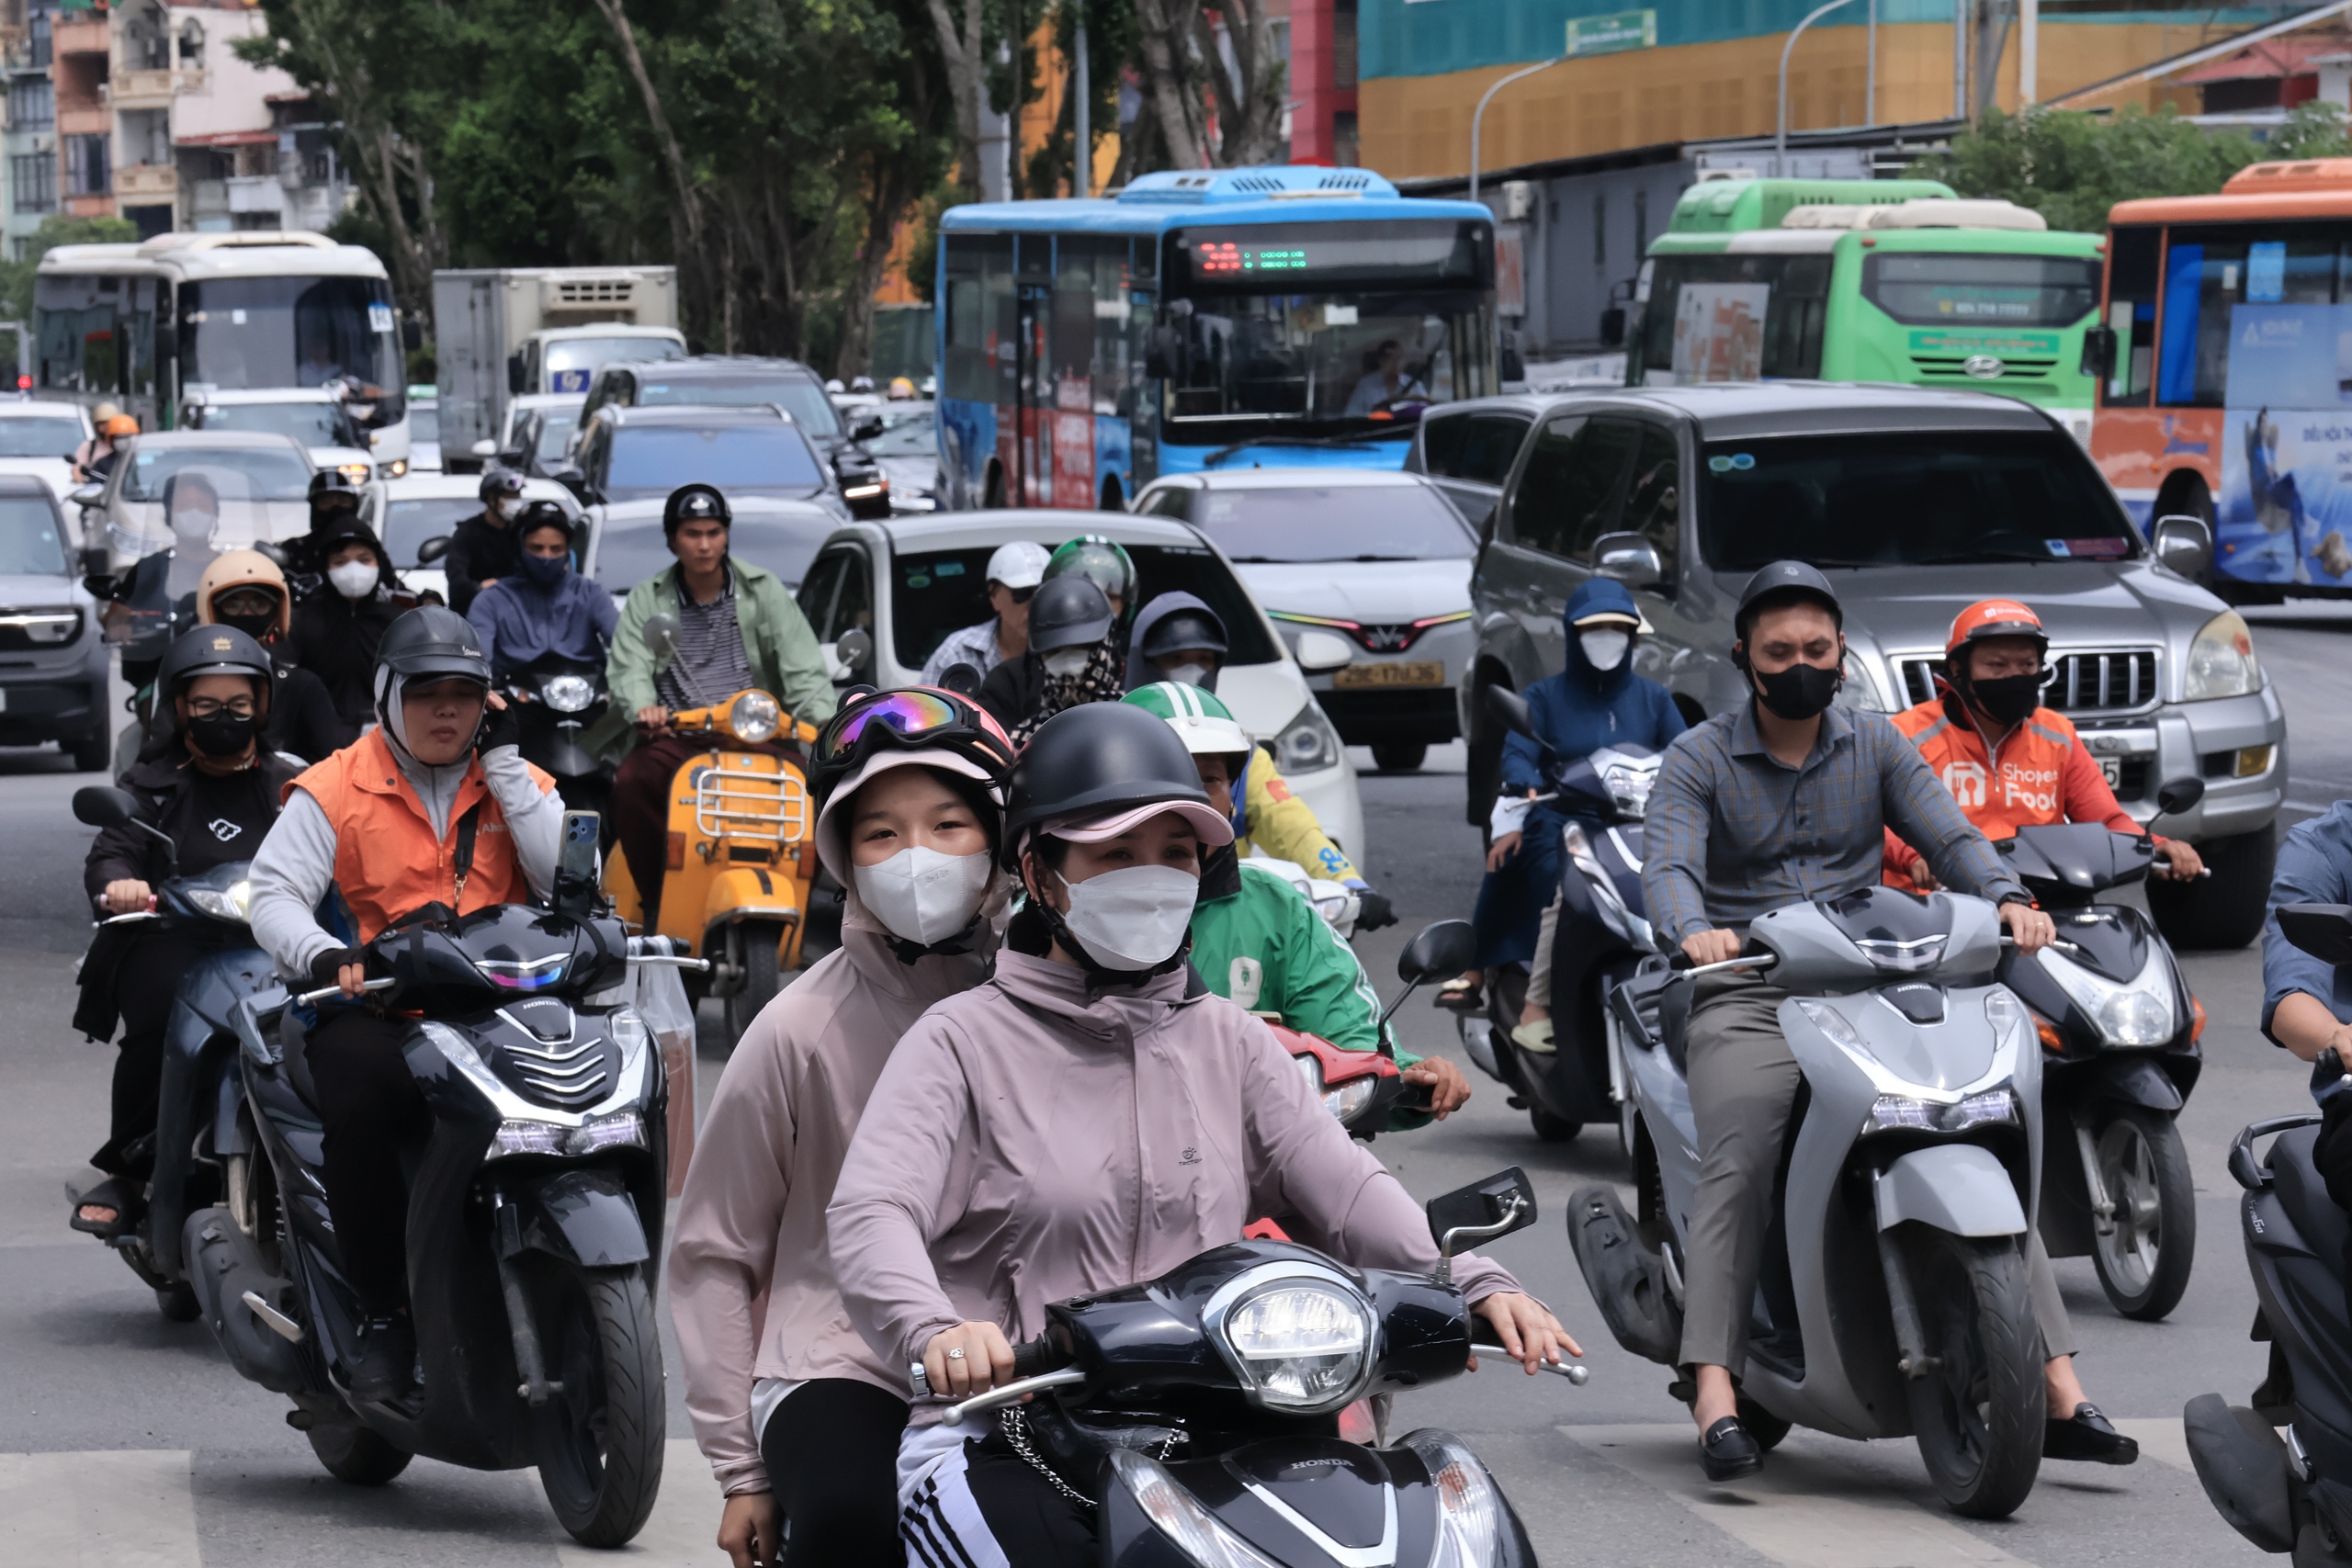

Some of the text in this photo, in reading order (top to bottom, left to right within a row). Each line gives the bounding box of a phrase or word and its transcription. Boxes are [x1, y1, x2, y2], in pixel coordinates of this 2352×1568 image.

[1896, 984, 1932, 993] HONDA
[523, 1000, 559, 1010] HONDA
[2248, 1199, 2266, 1234] FreeGo
[1291, 1458, 1355, 1471] HONDA
